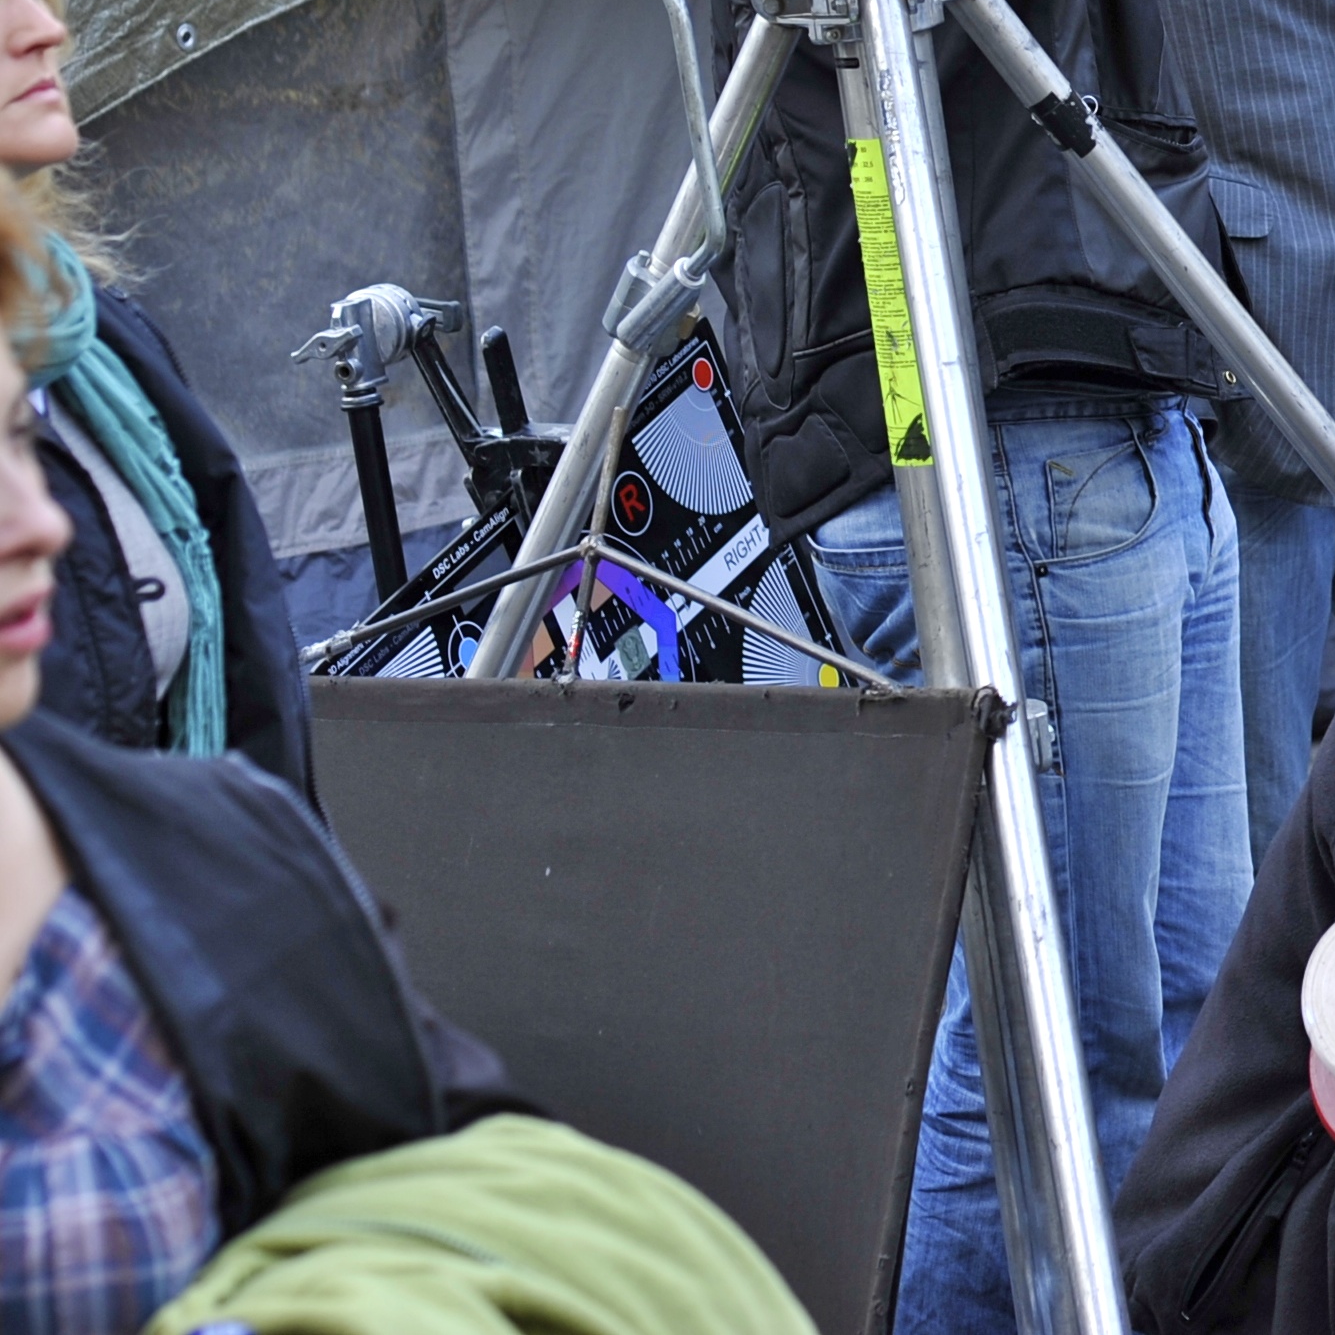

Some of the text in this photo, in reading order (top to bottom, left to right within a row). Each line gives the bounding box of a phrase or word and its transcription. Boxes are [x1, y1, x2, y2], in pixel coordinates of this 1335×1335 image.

[618, 483, 646, 521] R
[432, 507, 510, 579] DSC Labs CamAlign
[723, 524, 763, 572] RIGHT
